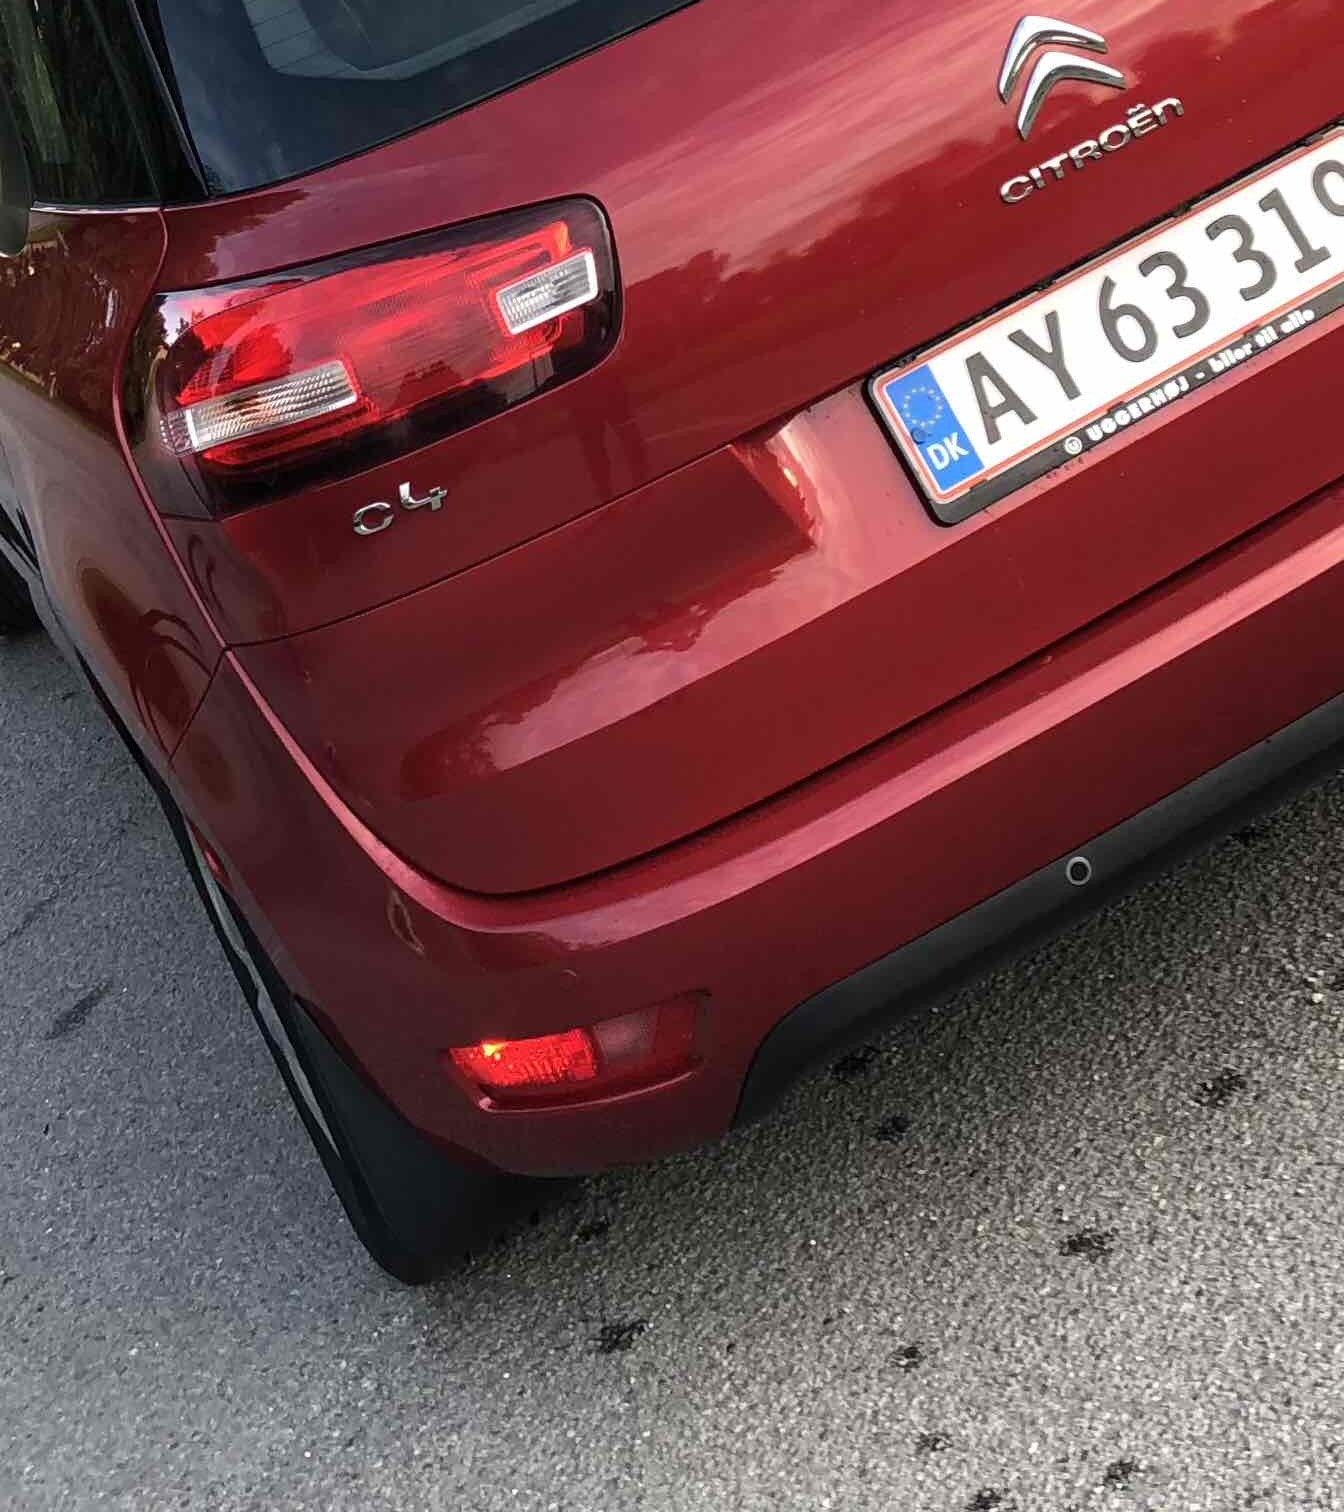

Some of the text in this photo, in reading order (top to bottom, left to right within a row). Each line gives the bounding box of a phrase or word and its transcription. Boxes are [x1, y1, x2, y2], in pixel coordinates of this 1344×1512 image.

[965, 310, 1082, 445] AY
[1098, 250, 1211, 363] 63
[927, 431, 970, 472] DK
[353, 481, 448, 536] C4
